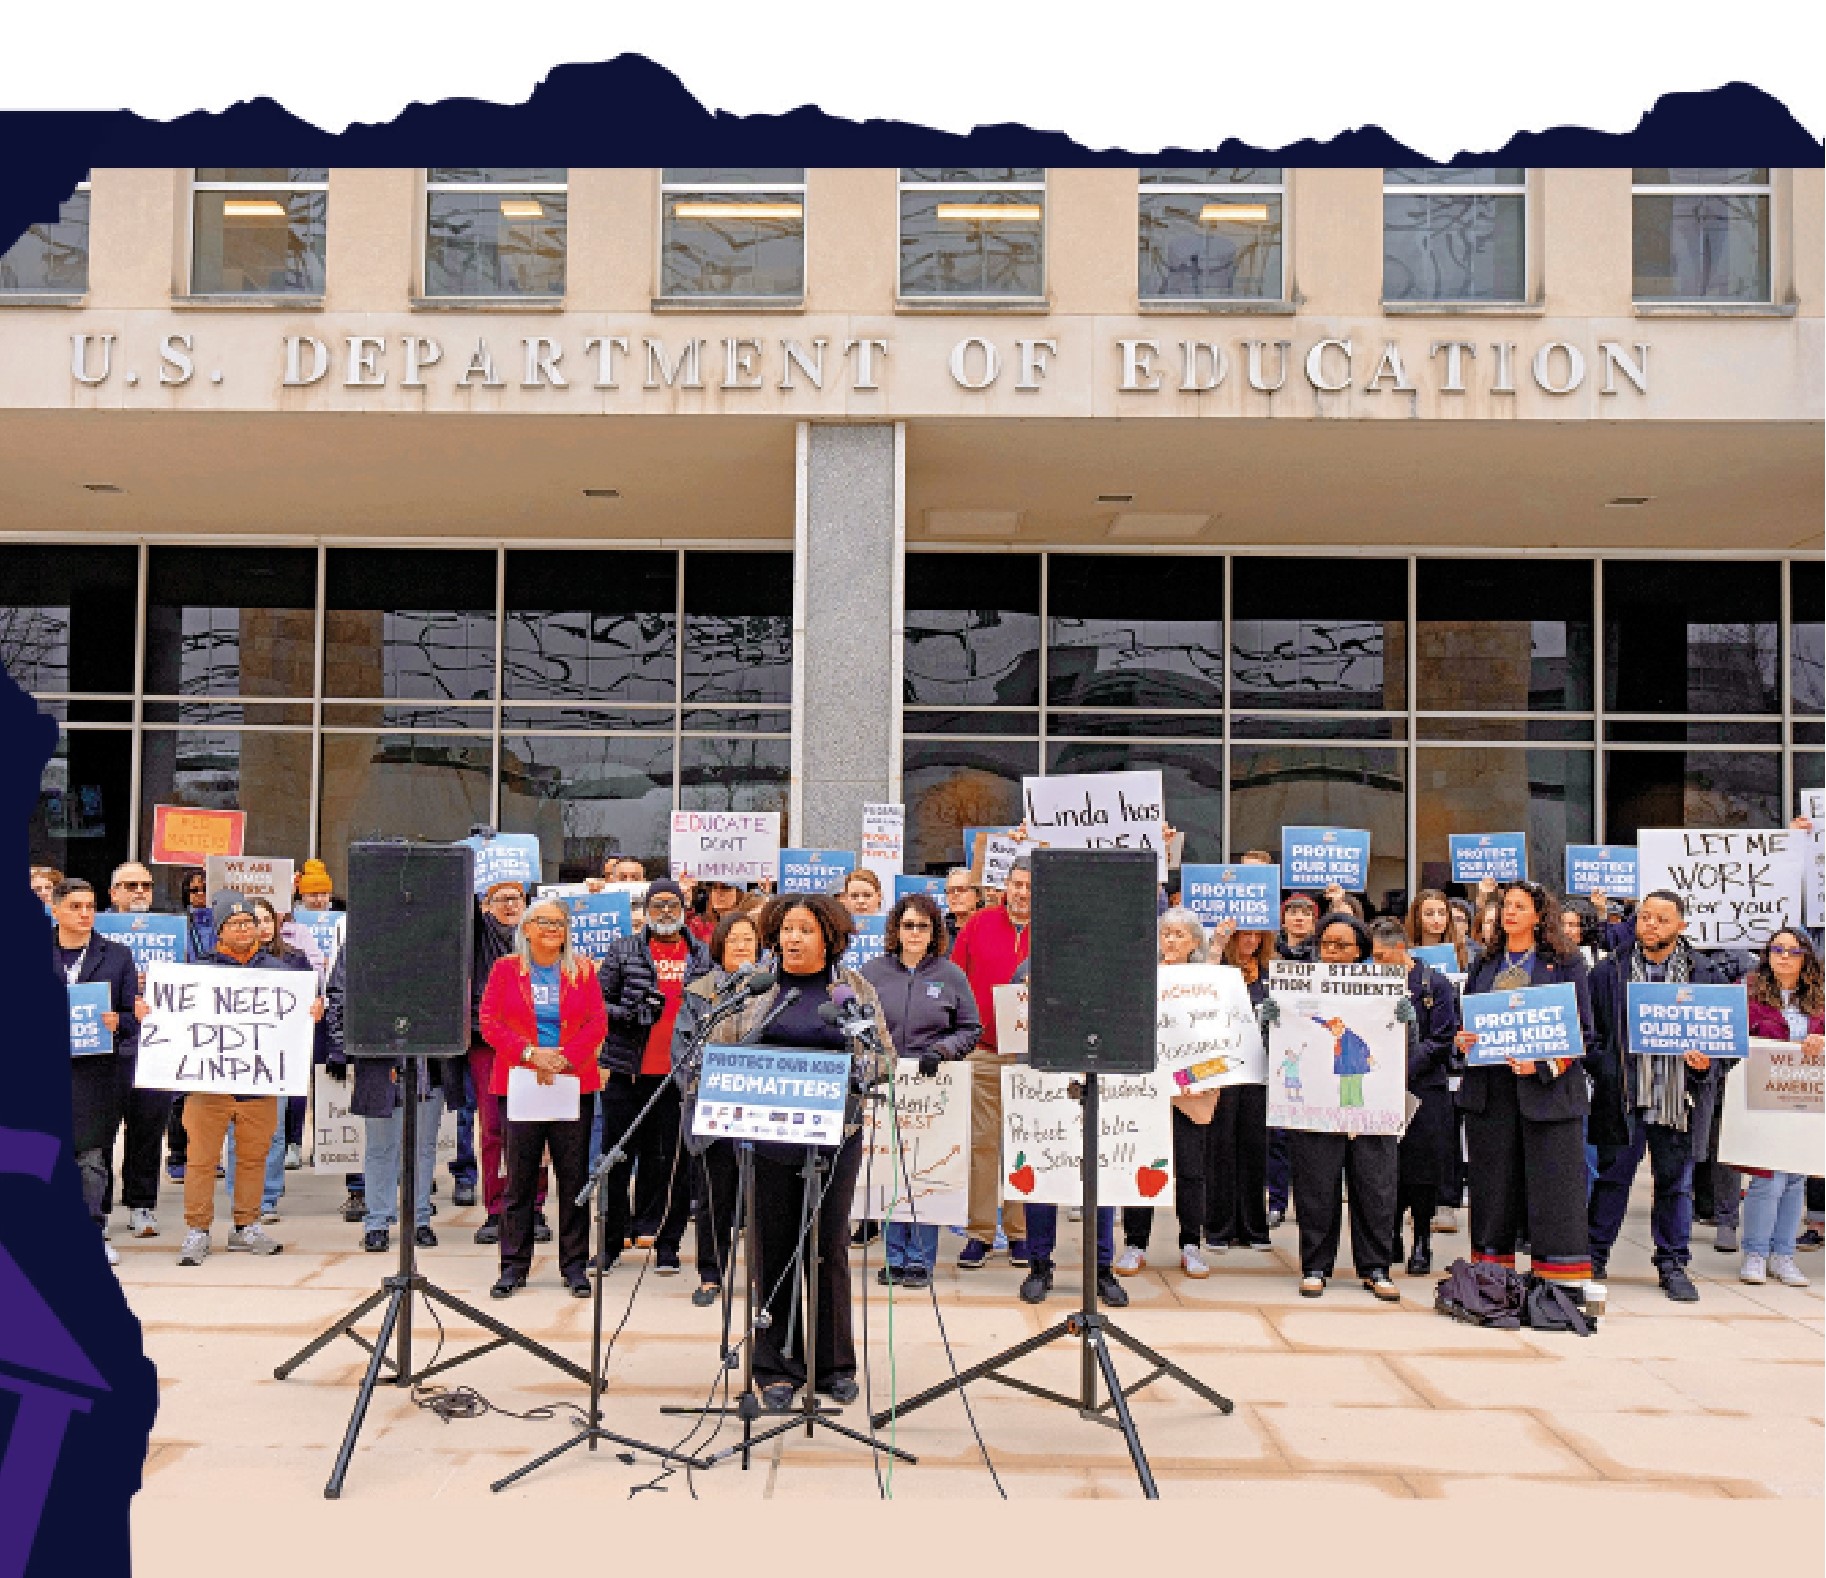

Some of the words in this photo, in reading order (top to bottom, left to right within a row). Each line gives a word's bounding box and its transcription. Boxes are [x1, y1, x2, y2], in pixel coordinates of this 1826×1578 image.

[70, 334, 225, 387] U.S.
[283, 335, 890, 391] DEPARTMENT
[949, 336, 1058, 391] OF
[1116, 339, 1652, 395] EDUCATION
[1026, 787, 1109, 828] Linda
[1119, 790, 1160, 823] has
[1292, 844, 1363, 860] PROTECT
[1683, 833, 1740, 857] LET
[1746, 833, 1791, 857] ME
[1456, 848, 1519, 860] PROTECT
[225, 861, 245, 872] WE
[671, 861, 774, 878] ELIMINATE
[784, 863, 846, 877] PROTECT
[1291, 861, 1326, 873] OUR
[1328, 862, 1360, 875] KIDS
[1574, 861, 1636, 873] PROTECT
[1667, 861, 1775, 897] WORK
[1191, 882, 1267, 898] PROTECT
[1191, 900, 1225, 915] OUR
[1229, 900, 1270, 914] KIDS
[1729, 896, 1790, 920] your
[582, 930, 622, 944] KIDS
[1276, 963, 1316, 975] STOP
[1271, 978, 1313, 991] FROM
[1320, 981, 1405, 996] STUDENTS
[153, 981, 201, 1013] WE
[212, 986, 297, 1020] NEED
[1474, 1005, 1565, 1029] PROTECT
[1639, 1003, 1734, 1021] PROTECT
[141, 1022, 172, 1048] 2
[186, 1022, 278, 1053] DDT
[1478, 1030, 1518, 1046] OUR
[1521, 1022, 1567, 1041] KIDS
[1639, 1022, 1682, 1037] OUR
[1686, 1024, 1734, 1039] KIDS
[706, 1052, 775, 1070] PROTECT
[777, 1057, 808, 1073] OUR
[812, 1060, 846, 1075] KIDS
[1770, 1053, 1794, 1066] WE
[706, 1072, 842, 1100] #EDMATTERS
